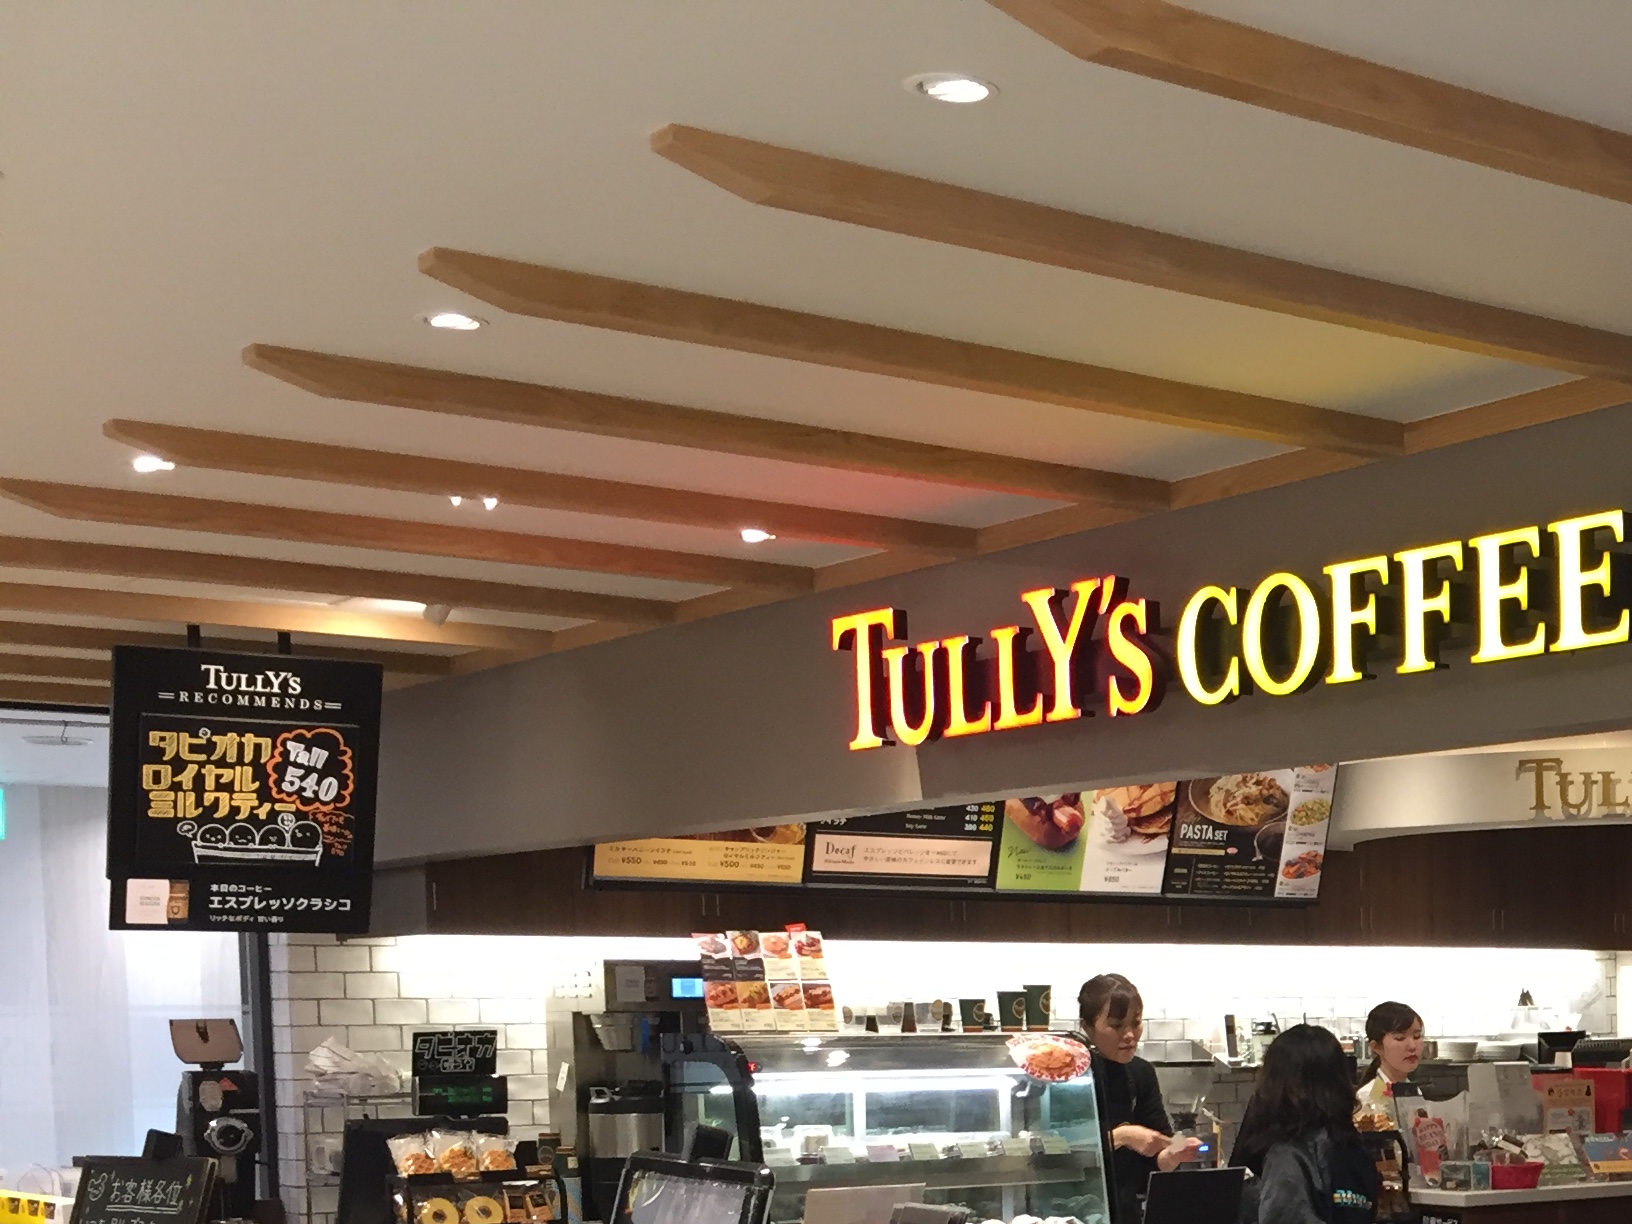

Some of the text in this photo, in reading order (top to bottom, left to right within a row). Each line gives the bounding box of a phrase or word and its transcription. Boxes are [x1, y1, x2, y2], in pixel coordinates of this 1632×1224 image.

[829, 509, 1632, 750] TULLY'S COFFEE
[201, 664, 302, 695] TULLY'S
[179, 691, 323, 710] RECOMMENDS
[149, 728, 272, 764] タピオカ
[286, 740, 330, 770] Tall
[142, 764, 260, 792] ロイヤル
[281, 768, 339, 802] 540
[148, 791, 297, 820] ミルクティー
[1180, 824, 1228, 841] PASTA SET
[825, 842, 857, 858] Decaf
[208, 896, 351, 911] エスプレッソクラシコ
[109, 1178, 182, 1206] お客様各位
